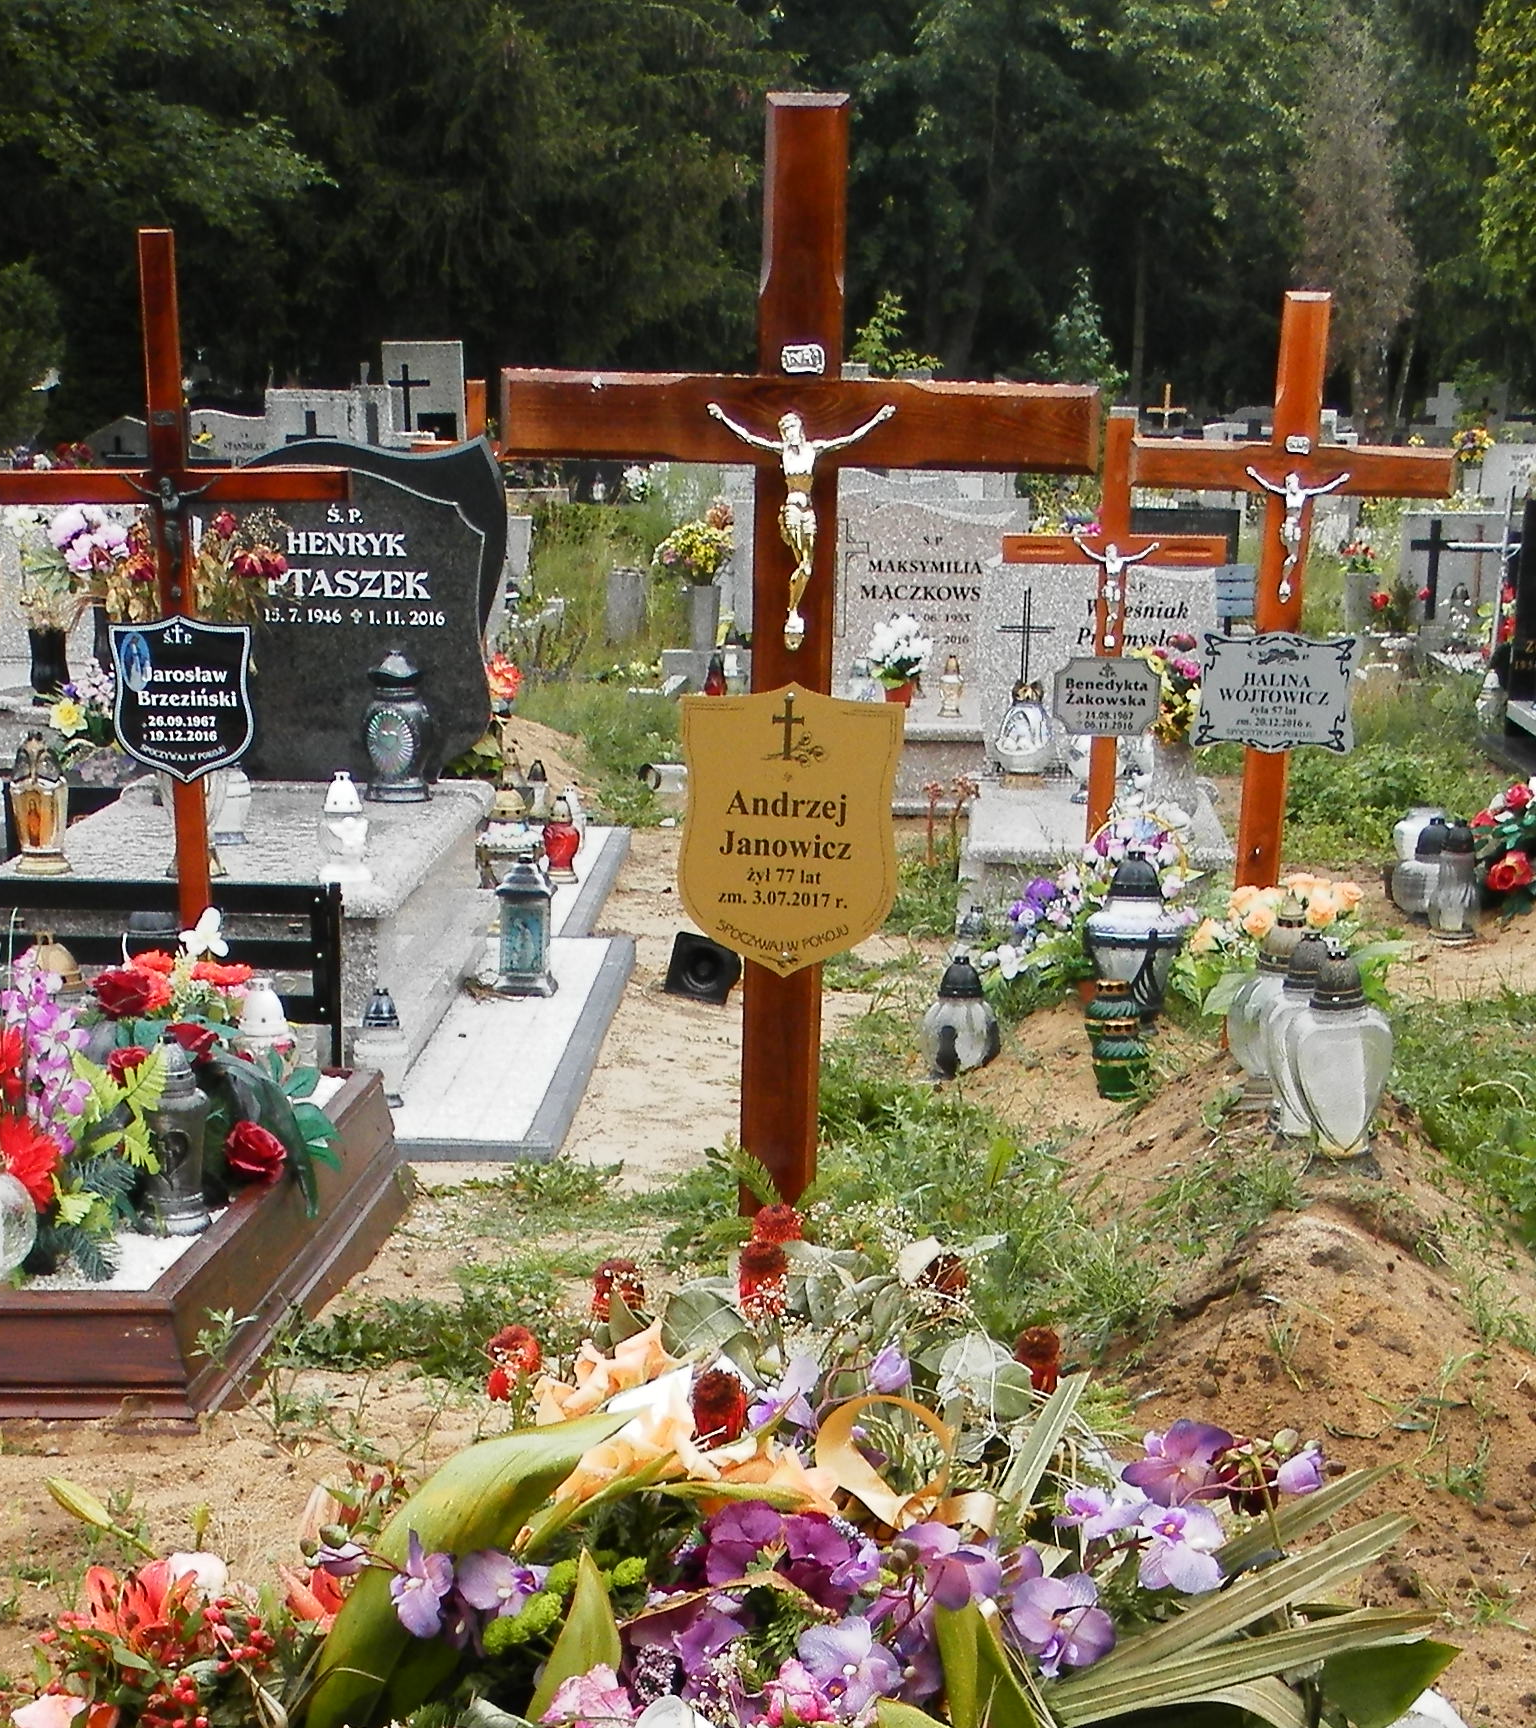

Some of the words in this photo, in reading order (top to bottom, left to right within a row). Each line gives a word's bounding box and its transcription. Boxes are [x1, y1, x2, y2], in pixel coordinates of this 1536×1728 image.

[286, 532, 407, 557] HENRYK
[268, 569, 431, 600] PTASZEK
[307, 609, 342, 624] 1946
[409, 611, 445, 626] 2016
[142, 667, 228, 683] Jarosław
[1242, 672, 1311, 688] HALINA
[1065, 678, 1148, 695] Benedykta
[1219, 684, 1329, 706] WÓJTOWICZ
[137, 688, 237, 707] Brzeziński
[1065, 689, 1146, 707] Żakowska
[148, 715, 216, 728] 26.09.1967
[150, 730, 218, 742] 19.12.2016
[726, 790, 848, 828] Andrzej
[719, 830, 852, 860] Janowicz
[747, 867, 770, 886] żył
[776, 868, 795, 883] 77
[800, 870, 822, 885] lat
[718, 891, 747, 904] zm.
[752, 890, 830, 908] 3.07.2017
[835, 898, 848, 909] r.
[715, 919, 784, 952] SPOCZYWAJ
[787, 941, 799, 951] W
[802, 924, 850, 951] POKOJU
